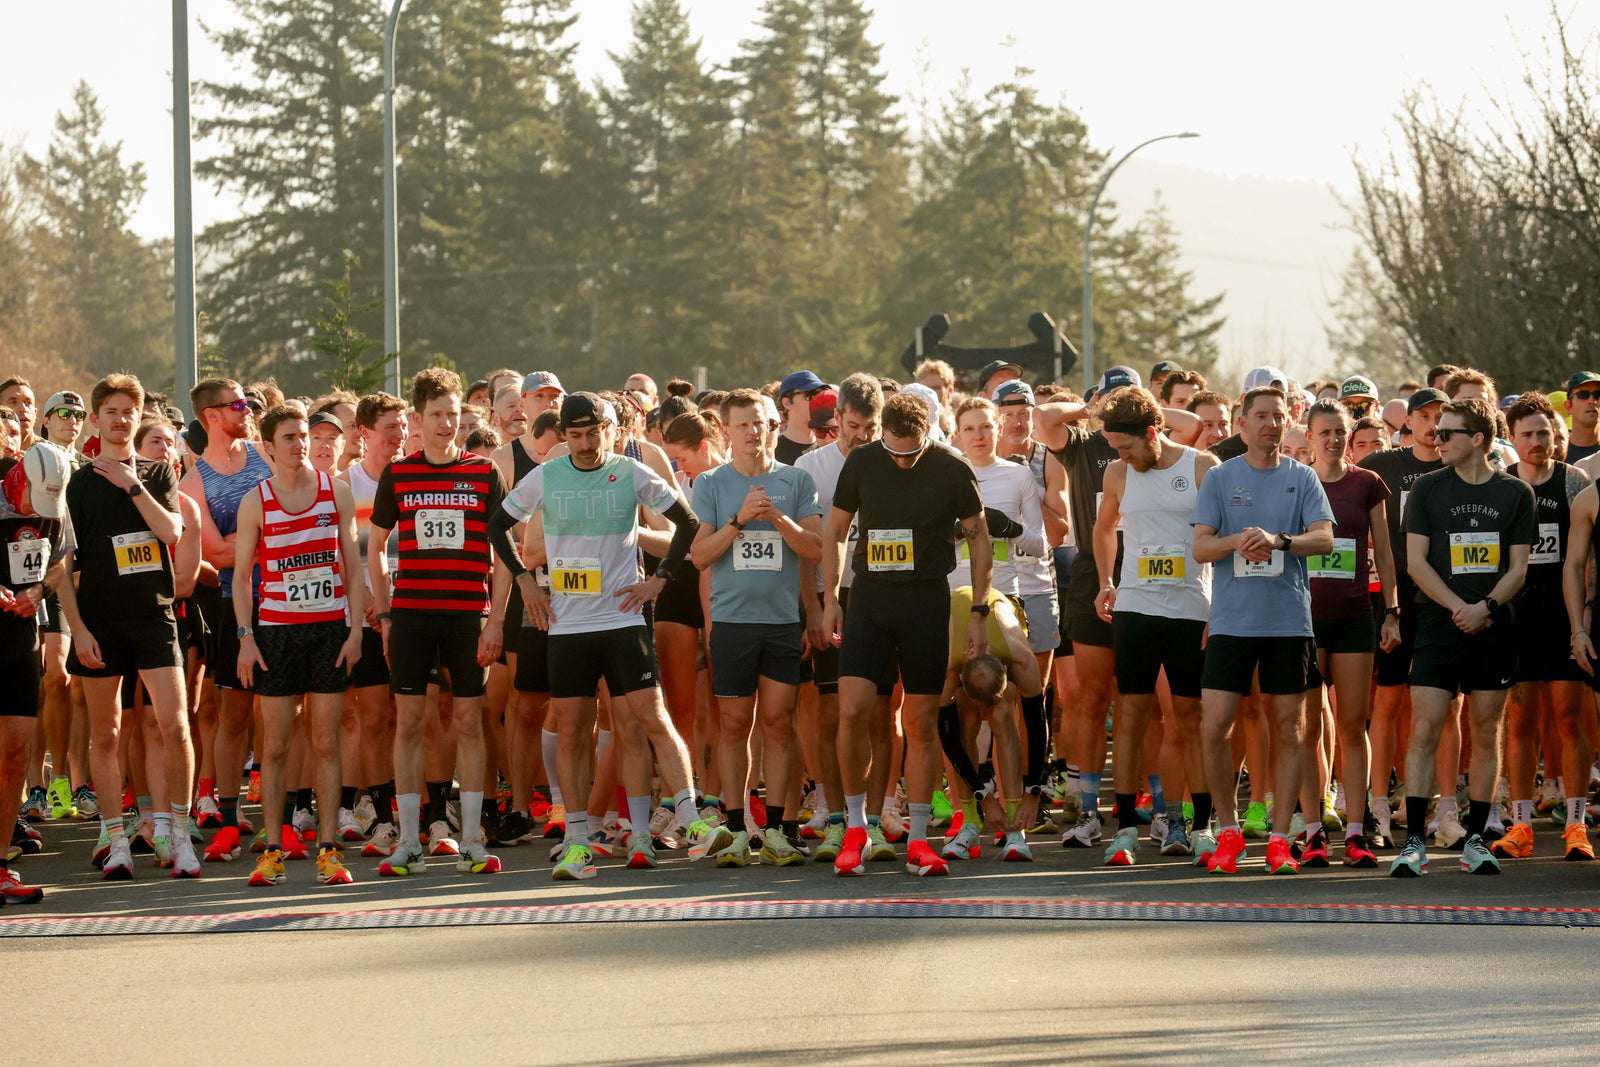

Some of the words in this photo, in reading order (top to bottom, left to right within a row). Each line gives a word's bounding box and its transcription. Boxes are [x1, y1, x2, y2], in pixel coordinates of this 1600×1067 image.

[1343, 382, 1368, 393] ciele
[404, 493, 478, 508] HARRIERS
[552, 489, 626, 519] TTL
[1450, 503, 1499, 518] SPEEDFARM
[423, 521, 456, 538] 313
[128, 546, 152, 564] M8
[741, 542, 775, 559] 334
[871, 544, 907, 561] M10
[1463, 547, 1490, 563] M2
[23, 551, 43, 571] 44
[277, 550, 336, 571] HARRIERS
[1149, 559, 1174, 576] M3
[564, 572, 587, 589] M1
[288, 580, 332, 602] 2176
